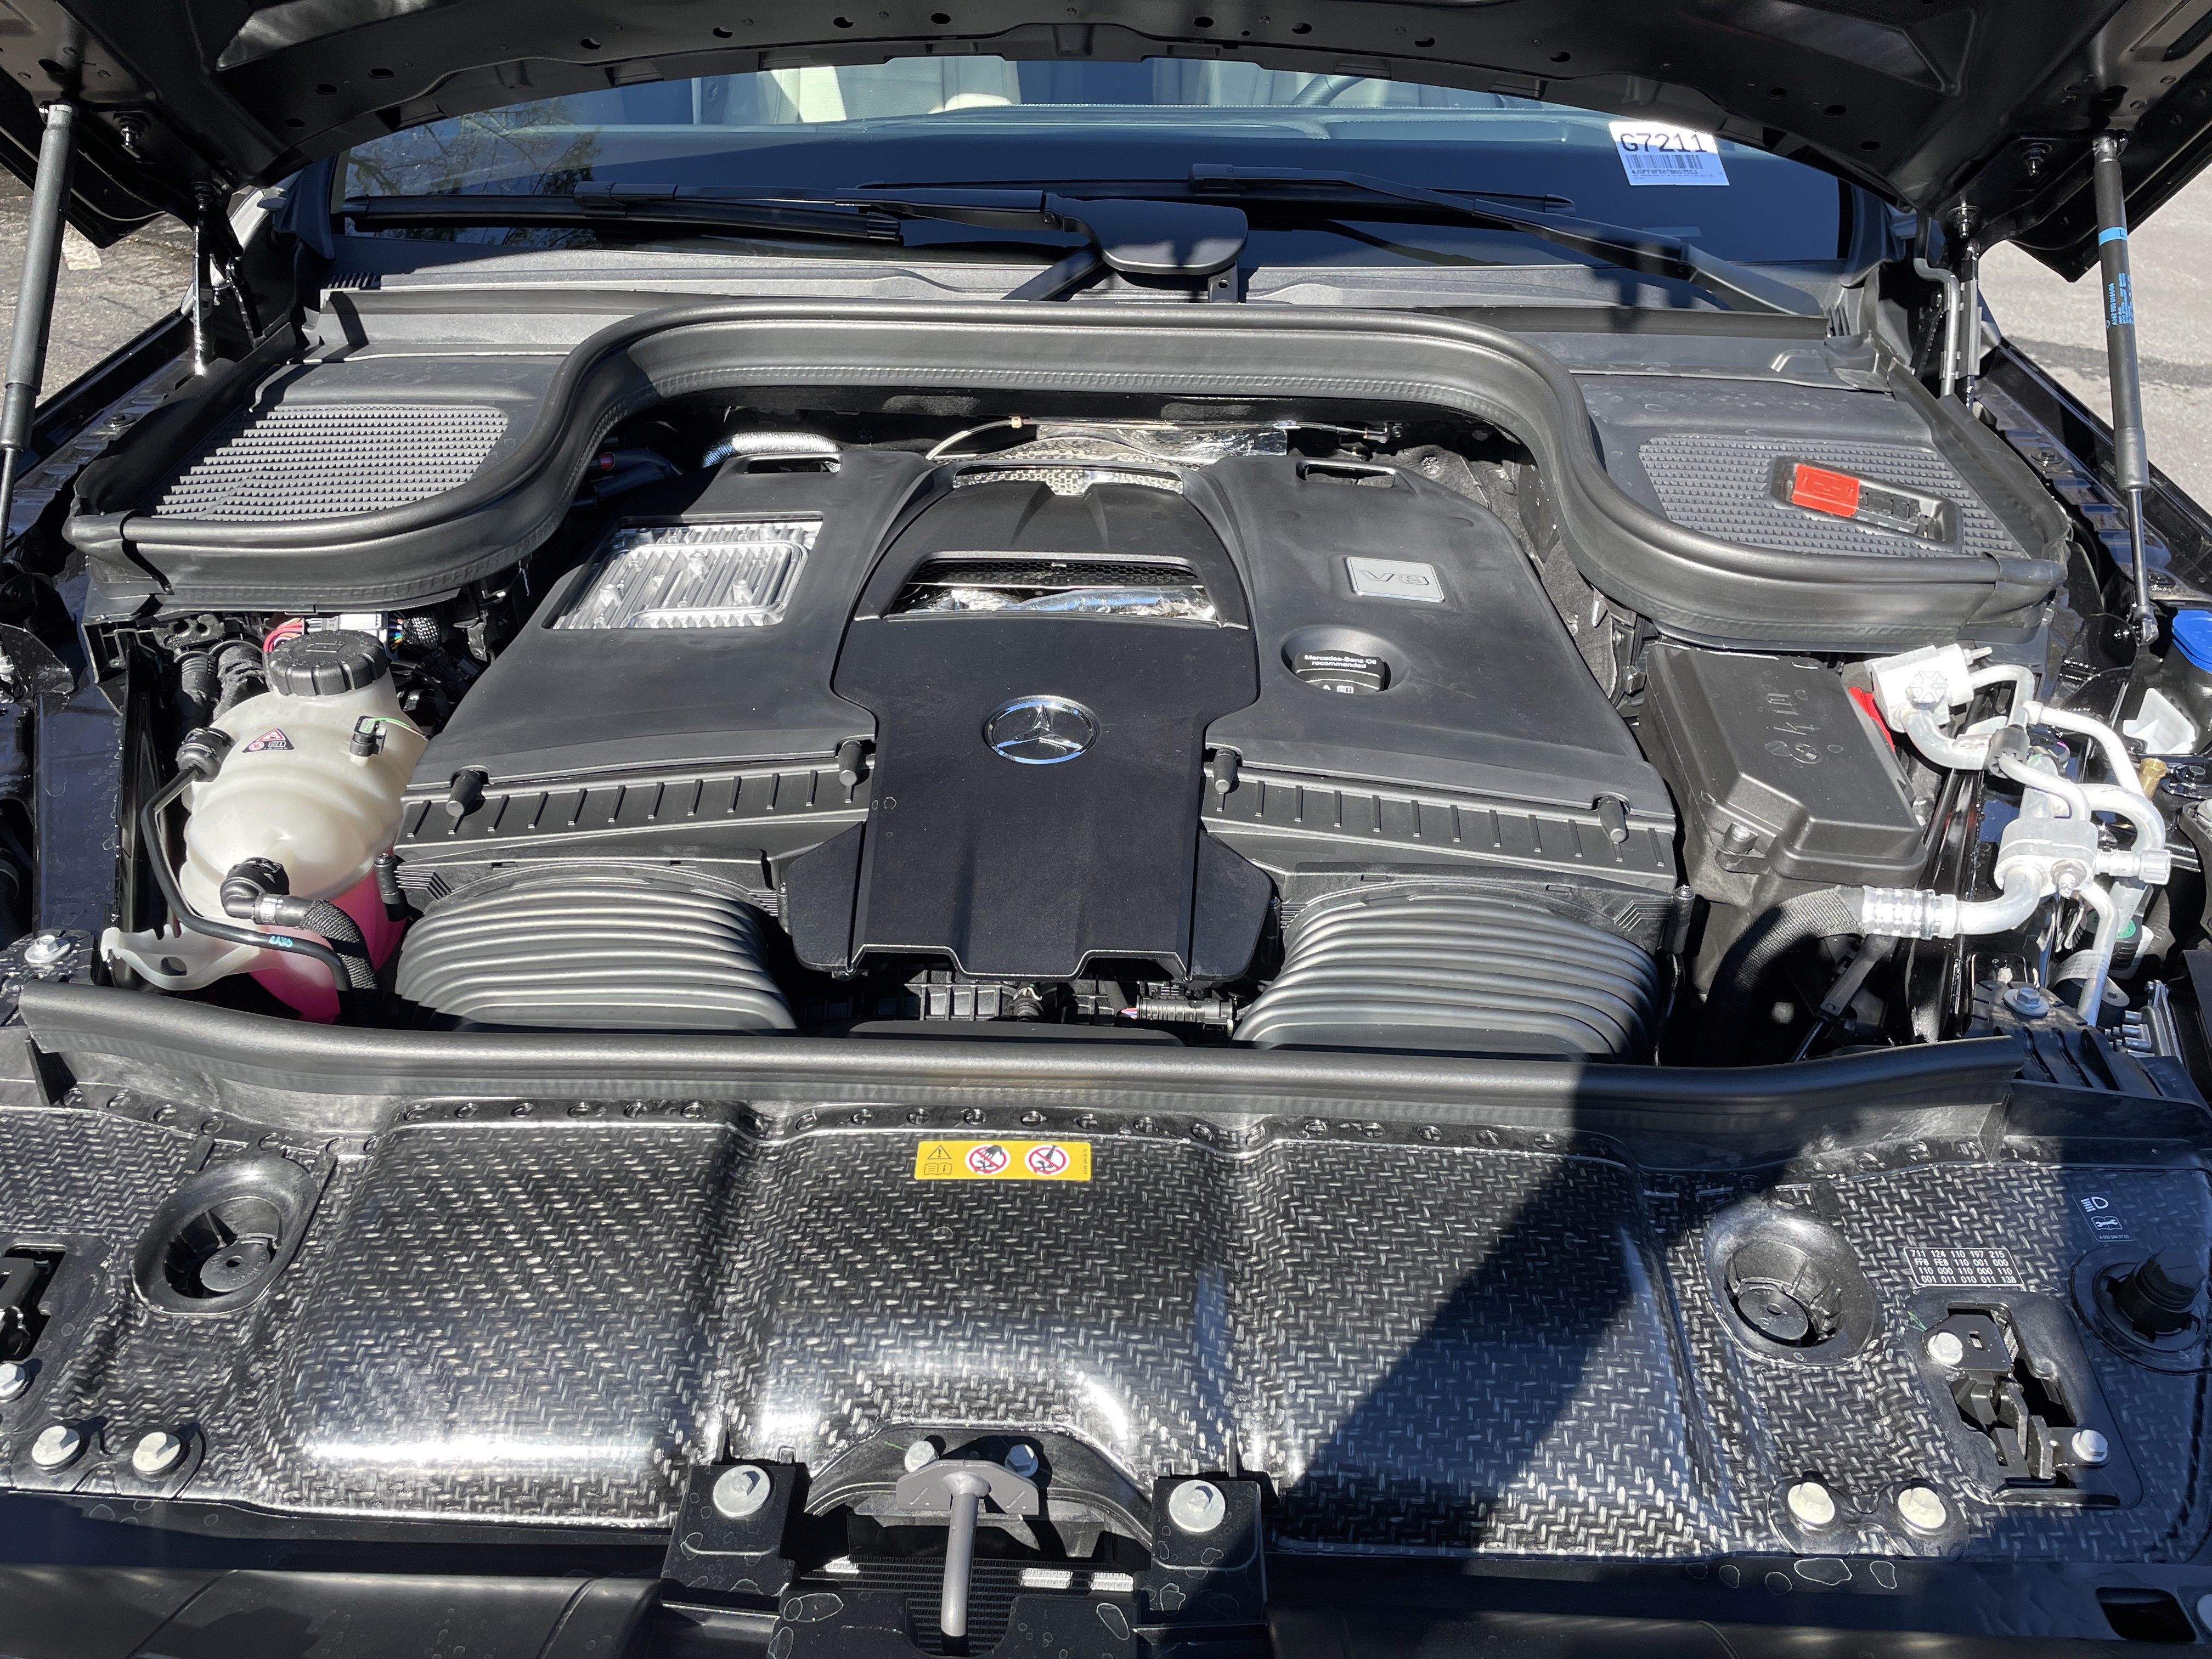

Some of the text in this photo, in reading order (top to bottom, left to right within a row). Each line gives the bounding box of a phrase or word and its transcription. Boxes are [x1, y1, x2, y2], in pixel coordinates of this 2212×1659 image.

[1621, 133, 1707, 152] G7211
[2119, 229, 2125, 237] L
[1359, 570, 1429, 585] V8
[1304, 655, 1364, 663] Mercedes-Benz
[1989, 1250, 2005, 1259] 215
